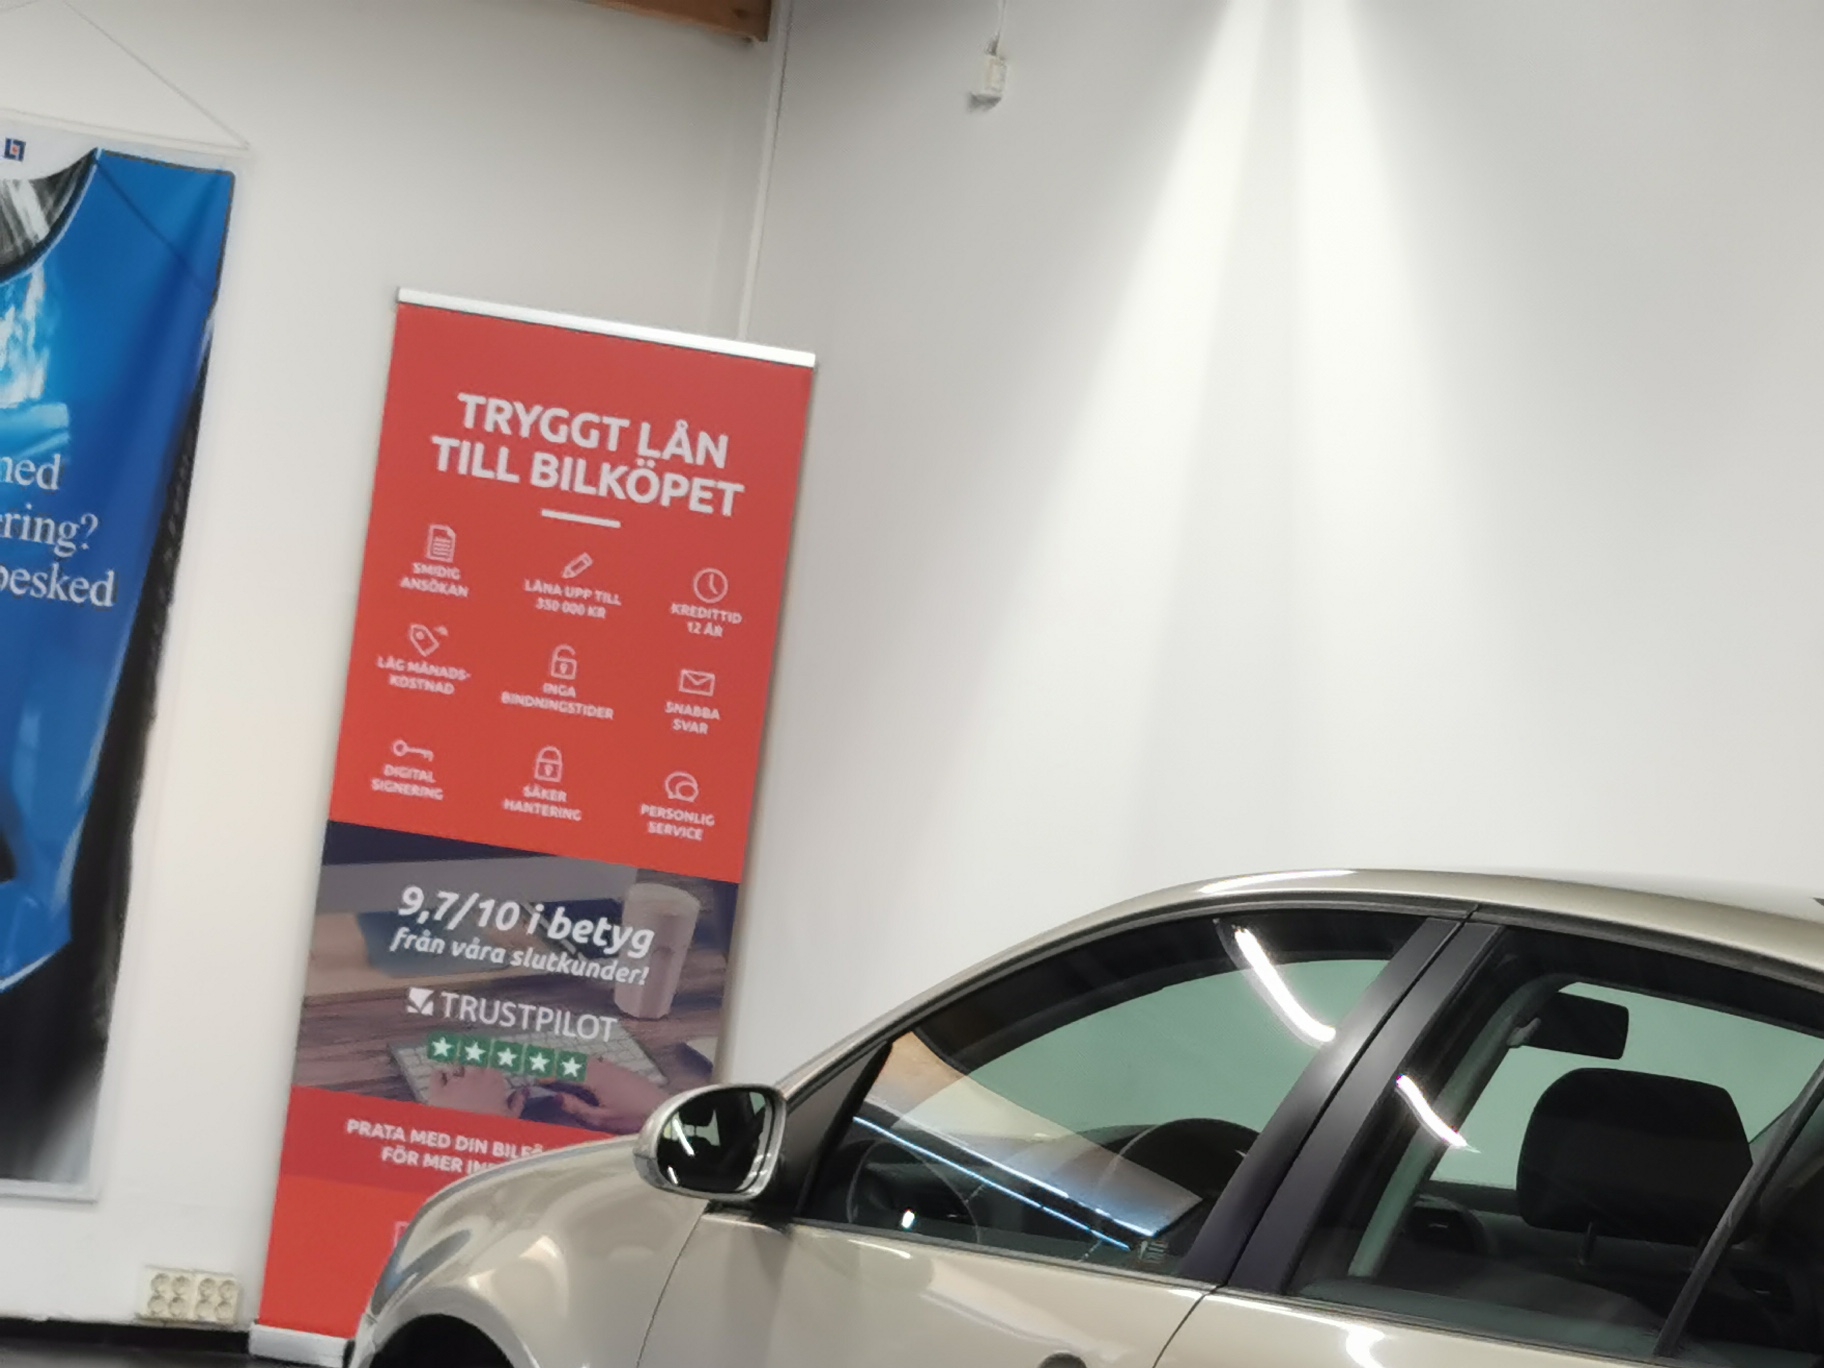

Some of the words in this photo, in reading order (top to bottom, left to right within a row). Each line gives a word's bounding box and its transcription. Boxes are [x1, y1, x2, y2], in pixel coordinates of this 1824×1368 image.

[457, 392, 630, 451] TRYGGT
[637, 419, 729, 469] LÅN
[431, 435, 520, 484] TILL
[529, 452, 745, 517] BILKÖPET
[412, 562, 461, 581] SMIDIG
[400, 577, 470, 598] ANSÖKAN
[564, 586, 594, 600] UPP
[595, 589, 622, 606] TILL
[670, 602, 743, 625] KREDITTID
[687, 621, 702, 635] 12
[389, 673, 455, 695] KOSTNAD
[543, 682, 577, 698] INGA
[501, 691, 614, 720] BINDNINGSTIDER
[665, 700, 721, 720] SNABBA
[672, 718, 709, 735] SVAR
[383, 764, 436, 783] DIGITAL
[371, 778, 444, 800] SIGNERING
[523, 784, 567, 802] SÄKER
[503, 798, 582, 821] HANTERING
[640, 803, 715, 826] PERSONLIG
[648, 821, 703, 841] SERVICE
[398, 886, 520, 931] 9,7/10
[526, 904, 545, 934] i
[547, 906, 655, 958] betyg
[390, 926, 446, 952] från
[450, 938, 504, 963] våra
[510, 948, 649, 985] slutkunder!
[441, 991, 617, 1042] TRUSTPILOT
[346, 1119, 406, 1141] PRATA
[410, 1130, 451, 1148] MED
[454, 1135, 488, 1154] DIN
[381, 1146, 418, 1166] FÖR
[423, 1153, 462, 1173] MER
